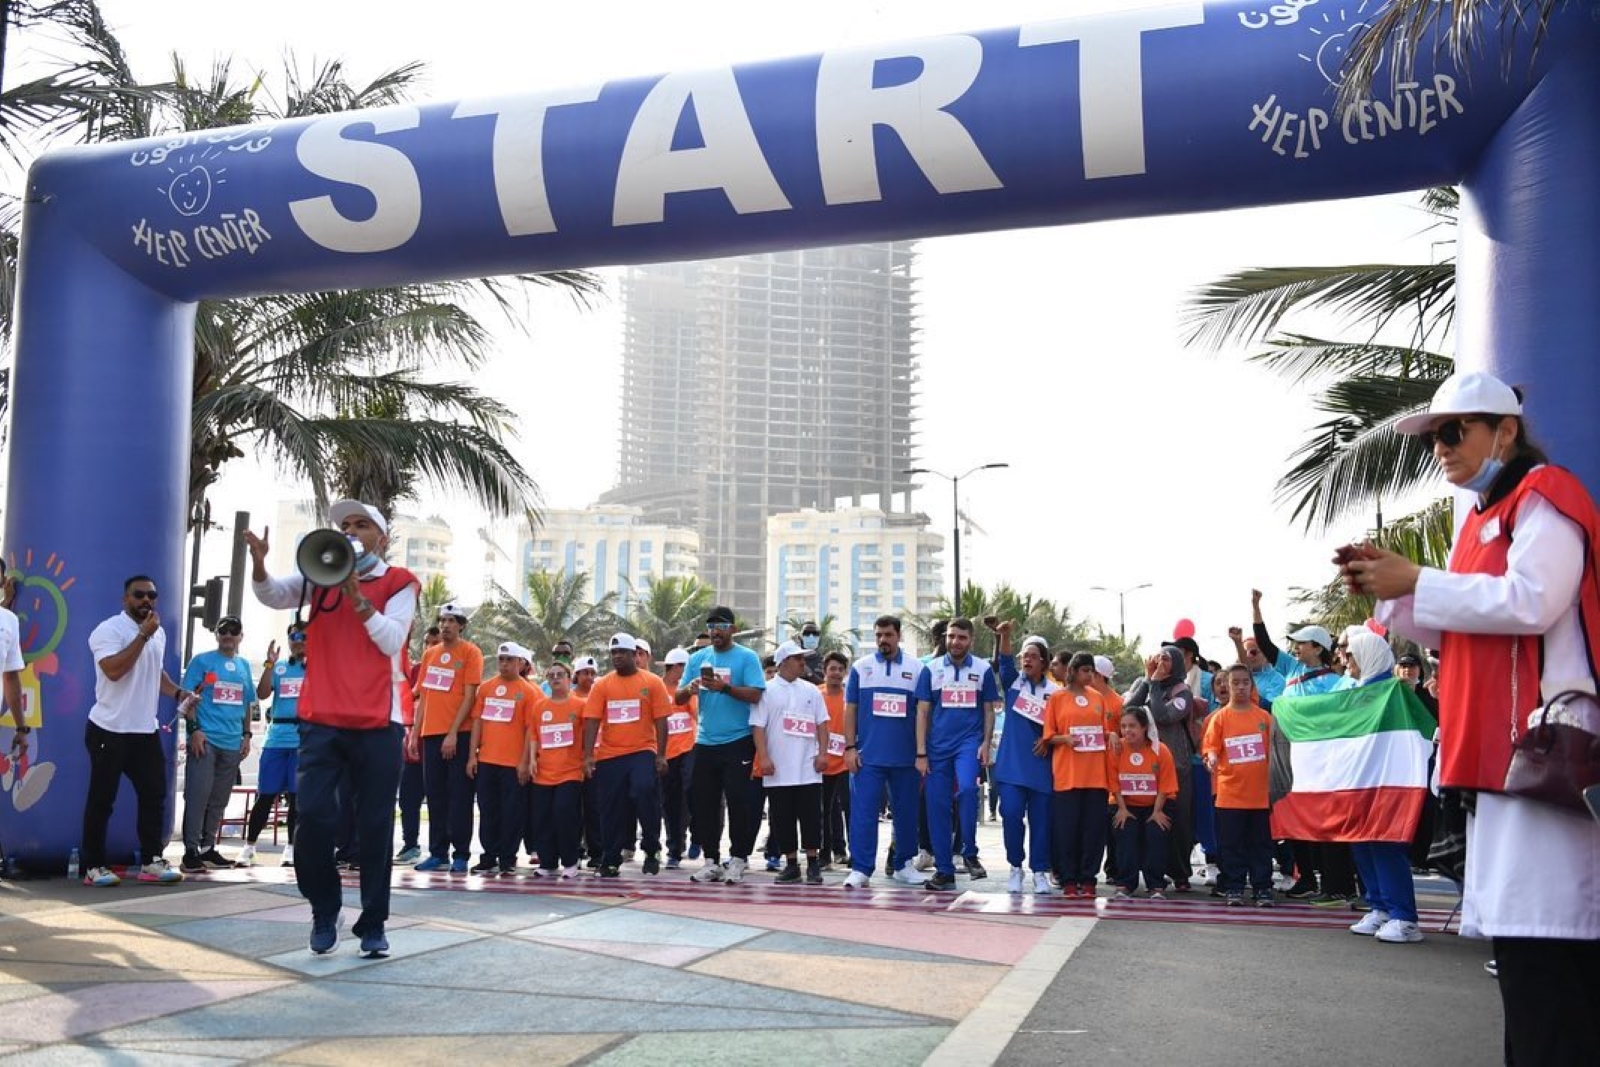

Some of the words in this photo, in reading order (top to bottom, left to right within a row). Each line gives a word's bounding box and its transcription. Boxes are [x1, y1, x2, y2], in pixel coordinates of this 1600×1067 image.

[1247, 94, 1328, 158] HELP
[1342, 74, 1463, 144] CENTER
[287, 0, 1206, 253] START
[132, 218, 190, 268] HELP
[194, 208, 272, 258] CENTER
[950, 690, 967, 702] 41
[494, 706, 503, 717] 2
[881, 701, 899, 712] 40
[1024, 702, 1041, 717] 39
[620, 708, 628, 719] 5
[670, 719, 685, 730] 16
[791, 720, 807, 731] 24
[553, 731, 562, 742] 8
[1079, 735, 1096, 747] 12
[1237, 743, 1257, 757] 15
[1130, 780, 1149, 791] 14
